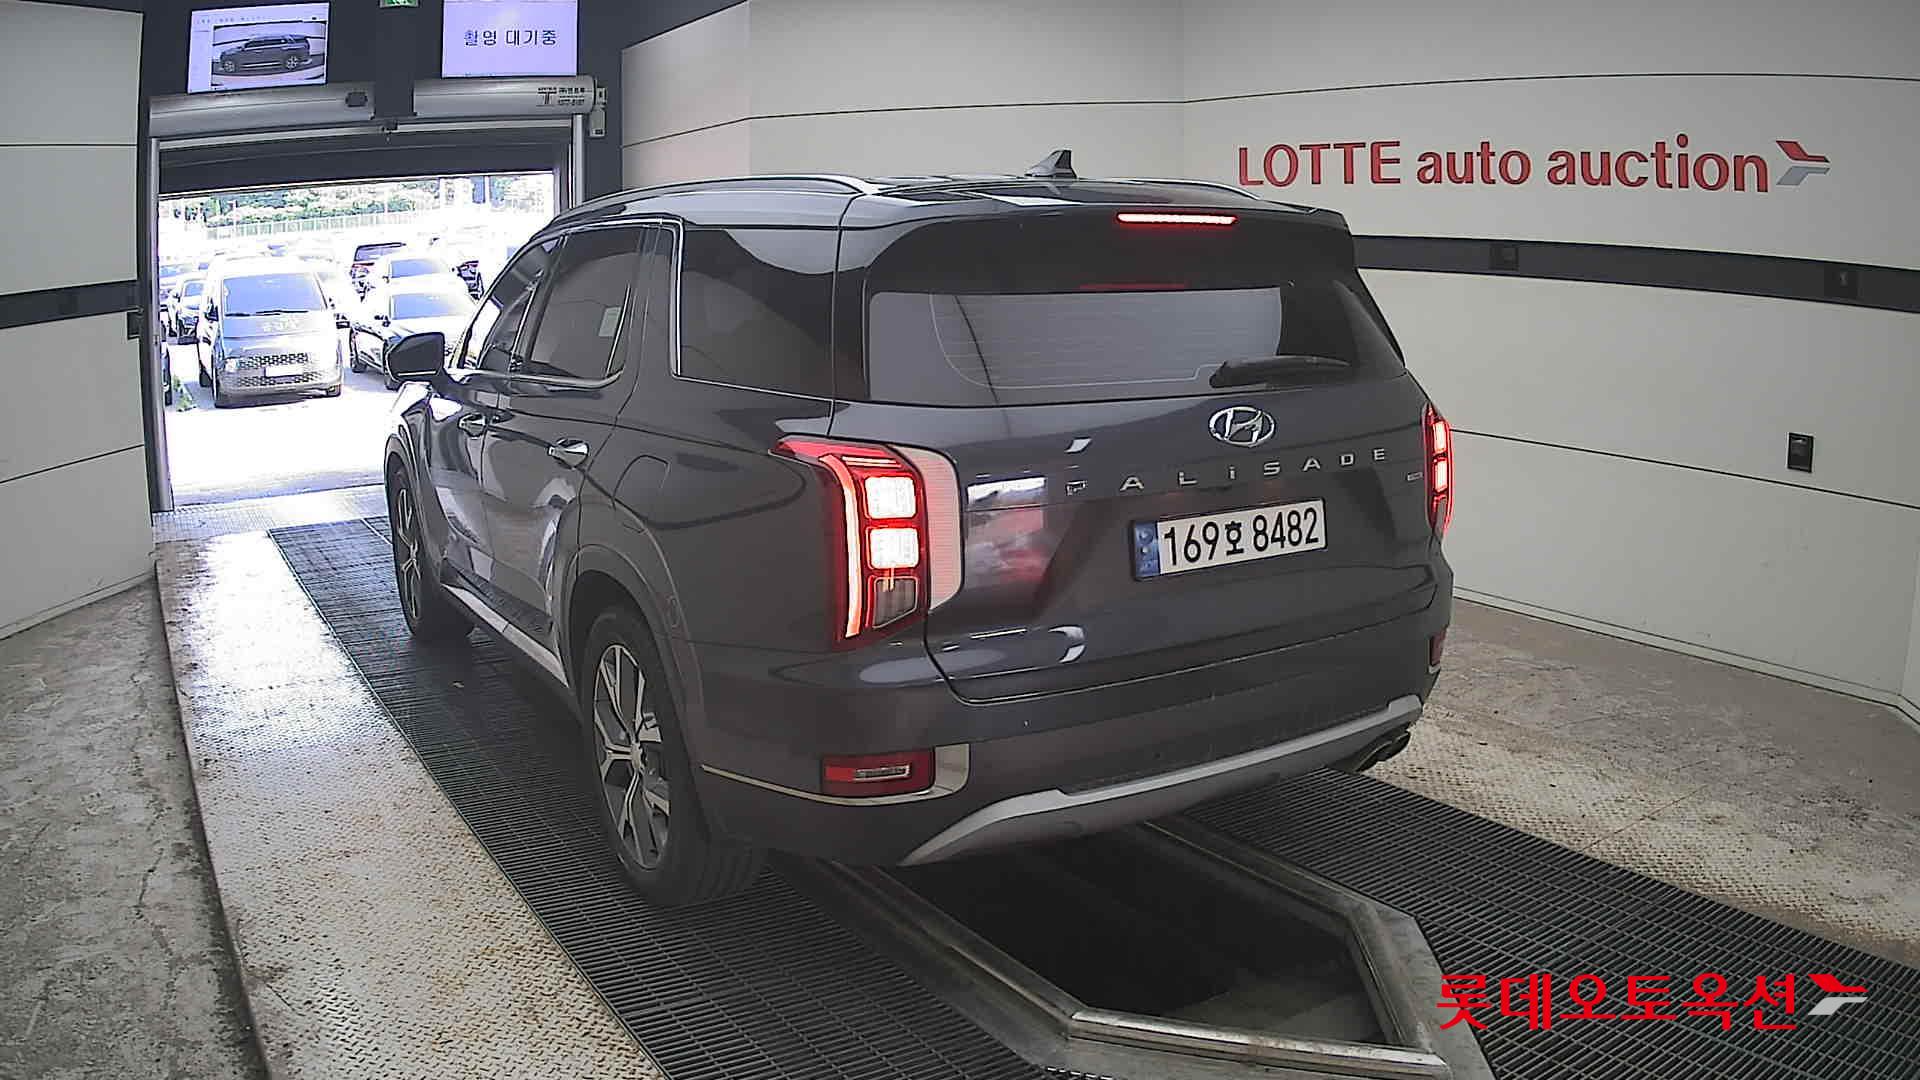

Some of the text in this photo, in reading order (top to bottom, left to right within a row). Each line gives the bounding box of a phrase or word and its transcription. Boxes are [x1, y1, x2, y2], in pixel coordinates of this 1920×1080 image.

[506, 29, 556, 46] 대기중
[1238, 133, 1769, 192] LOTTE auto auction
